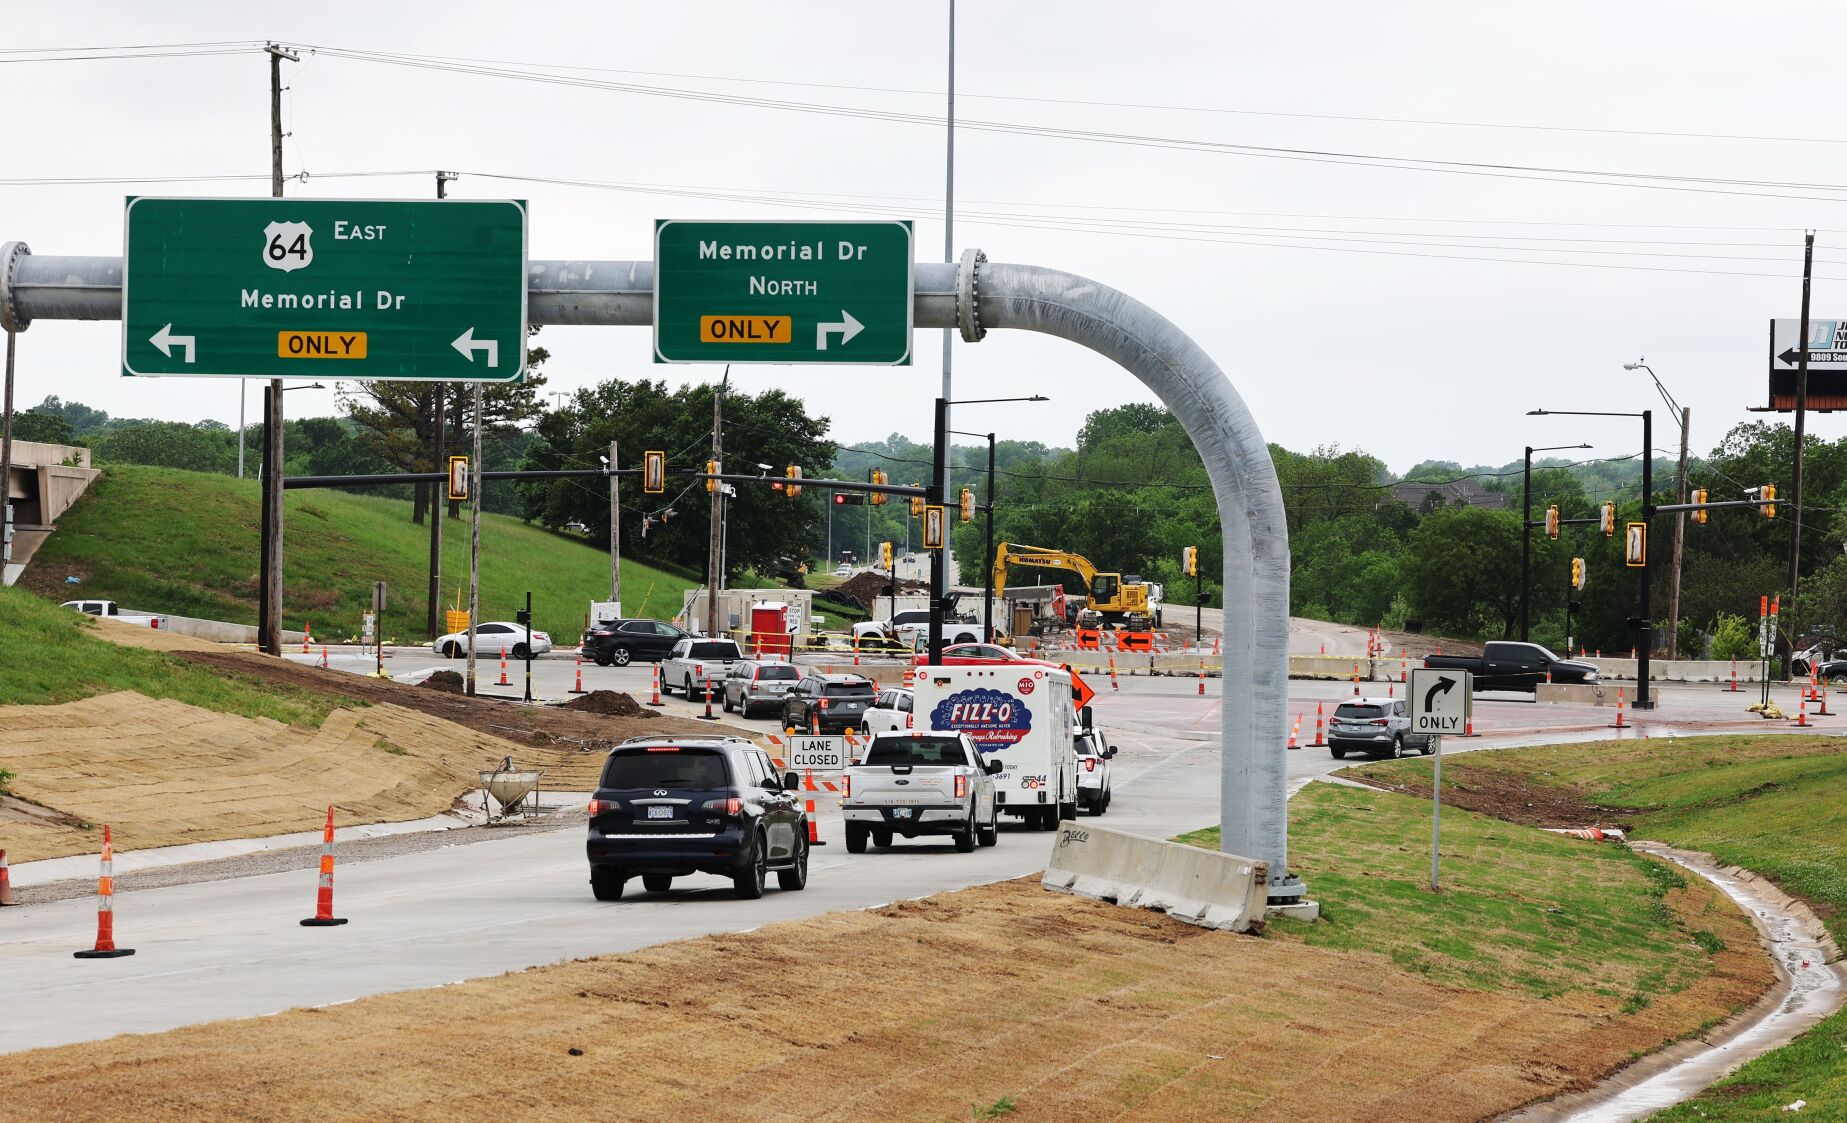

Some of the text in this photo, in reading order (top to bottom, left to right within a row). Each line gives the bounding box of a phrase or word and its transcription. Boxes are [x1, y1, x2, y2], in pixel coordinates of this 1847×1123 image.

[334, 220, 386, 240] EAST
[268, 233, 307, 261] 64
[699, 240, 867, 260] Memorial Dr
[749, 276, 817, 295] NORTH
[241, 289, 406, 310] Memorial Dr
[711, 319, 780, 339] ONLY
[288, 335, 356, 355] ONLY
[1811, 353, 1831, 361] 9809
[1019, 556, 1050, 564] KOMATSU
[950, 703, 1012, 723] FIZZ-O
[1419, 716, 1459, 729] ONLY
[802, 740, 832, 751] LANE
[794, 754, 839, 765] CLOSED
